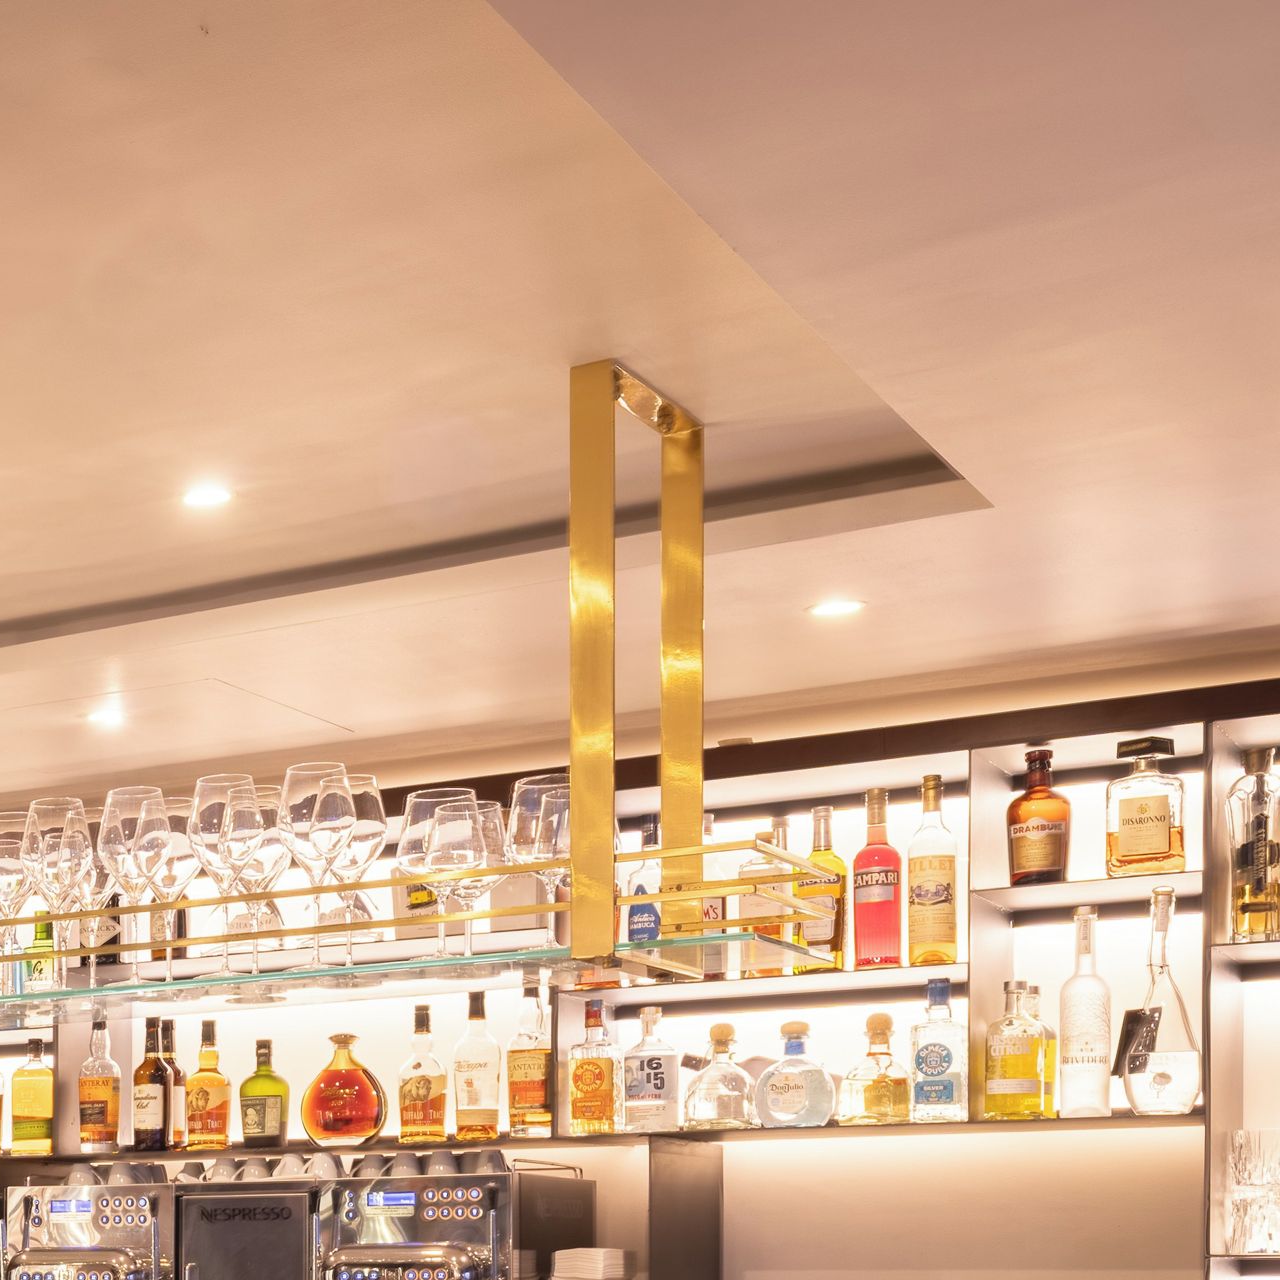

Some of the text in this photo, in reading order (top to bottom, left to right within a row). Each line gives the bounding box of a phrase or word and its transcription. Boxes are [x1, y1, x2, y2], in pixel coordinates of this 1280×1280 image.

[1122, 815, 1166, 826] DISARONNO
[1012, 823, 1063, 835] DRAMBUIE
[919, 1044, 950, 1060] OLMECA
[509, 1063, 544, 1071] ANTATIO
[640, 1057, 663, 1071] 16
[919, 1062, 949, 1076] TEQUILA
[576, 1079, 601, 1092] TEQUILA
[646, 1072, 665, 1090] 15
[200, 1206, 292, 1222] NESPRESSO
